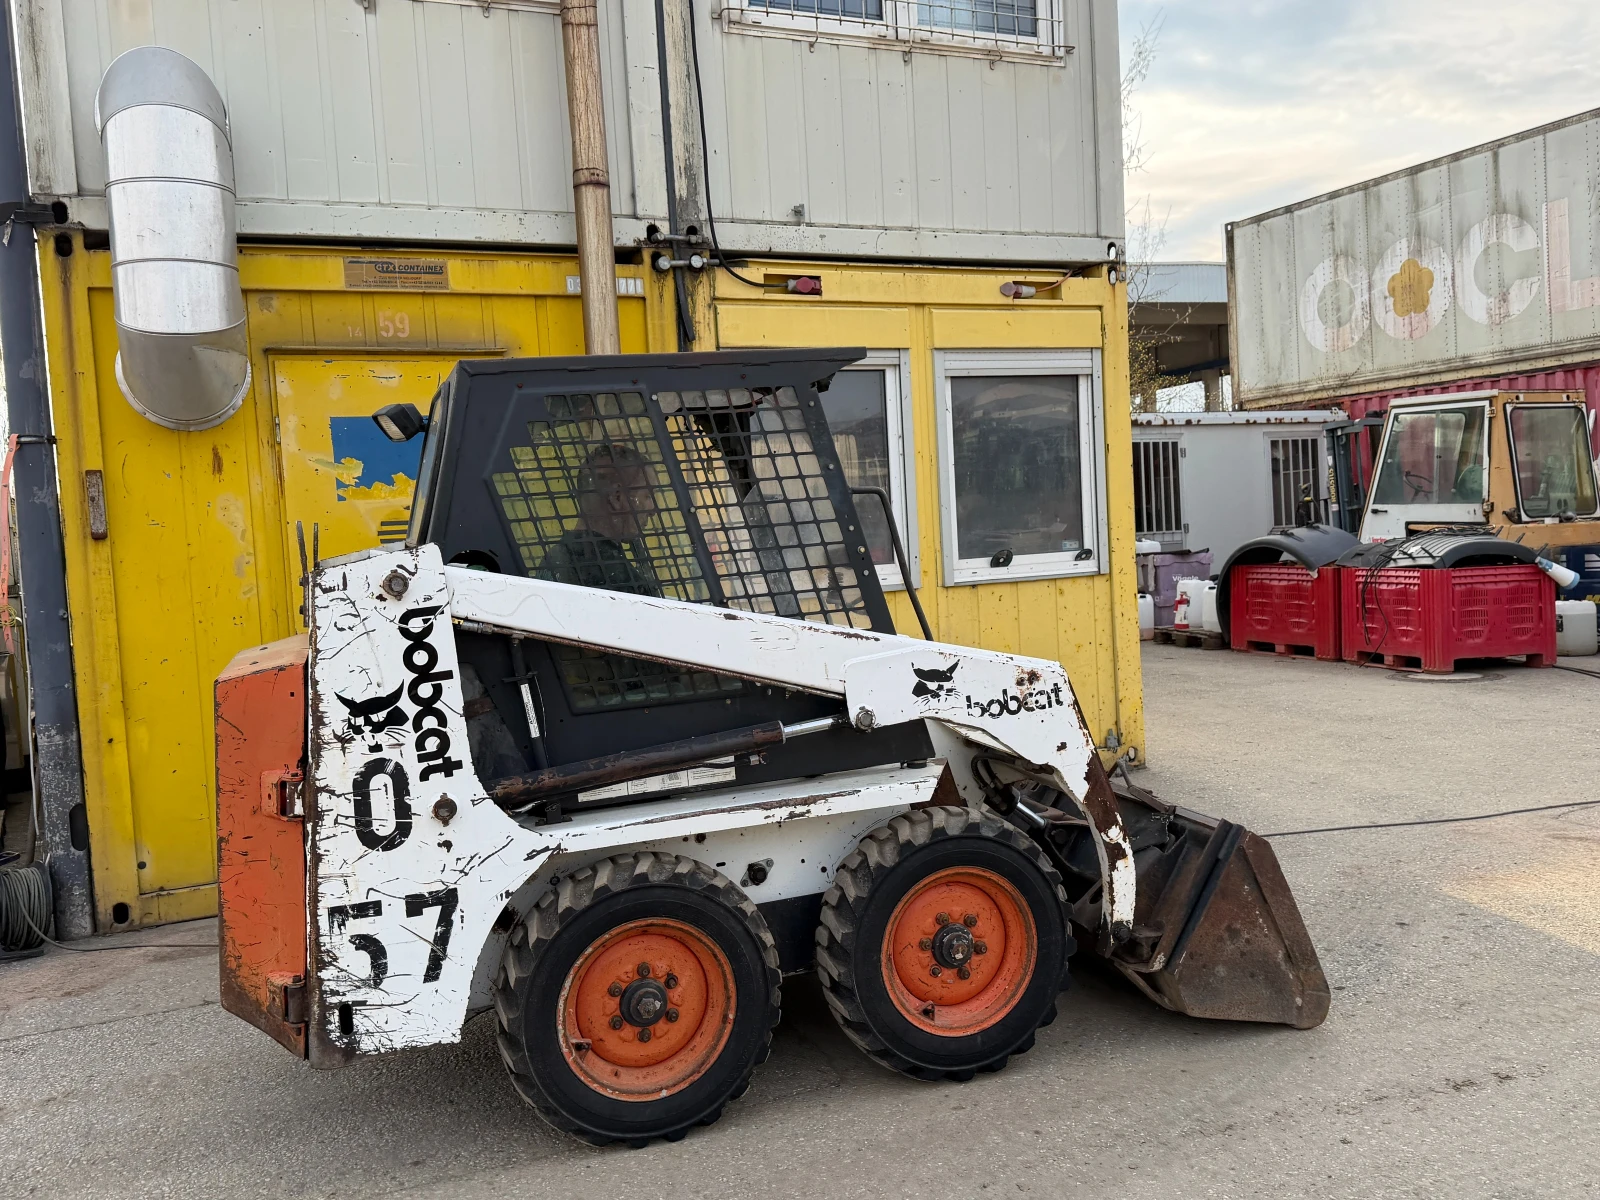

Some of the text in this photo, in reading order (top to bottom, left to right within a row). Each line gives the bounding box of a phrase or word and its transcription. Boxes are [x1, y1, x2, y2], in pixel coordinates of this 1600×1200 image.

[398, 264, 444, 272] CONTAINEX
[379, 311, 410, 338] 59
[398, 603, 463, 783] bobcat
[966, 682, 1064, 720] bobcat
[328, 887, 459, 989] 57
